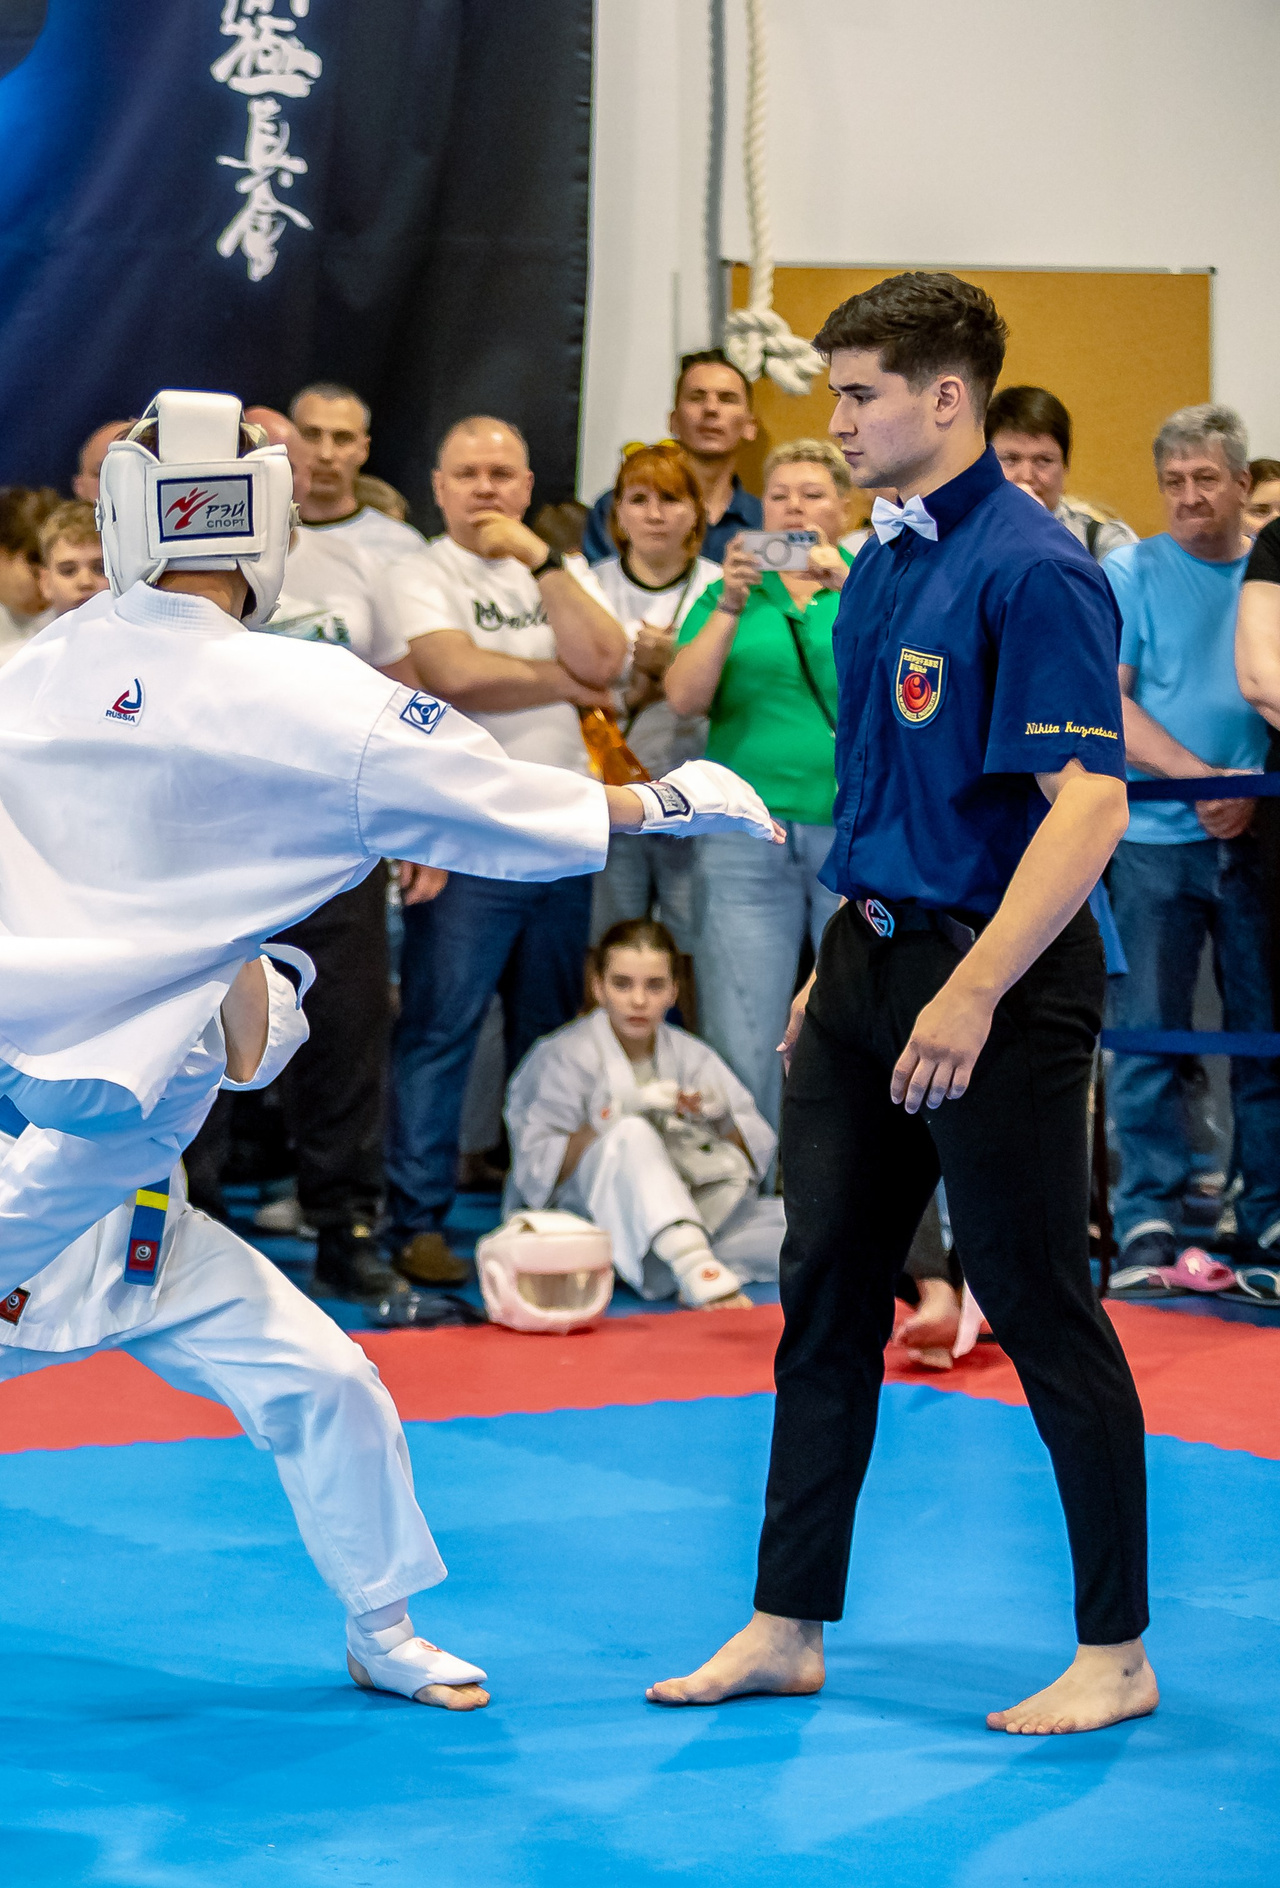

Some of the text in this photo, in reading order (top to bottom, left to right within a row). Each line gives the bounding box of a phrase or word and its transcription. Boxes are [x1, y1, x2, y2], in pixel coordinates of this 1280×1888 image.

[206, 500, 245, 519] РЭЙ
[206, 519, 245, 528] СПОРТ
[105, 710, 136, 723] RUSSIA
[1025, 722, 1060, 735] Nikita
